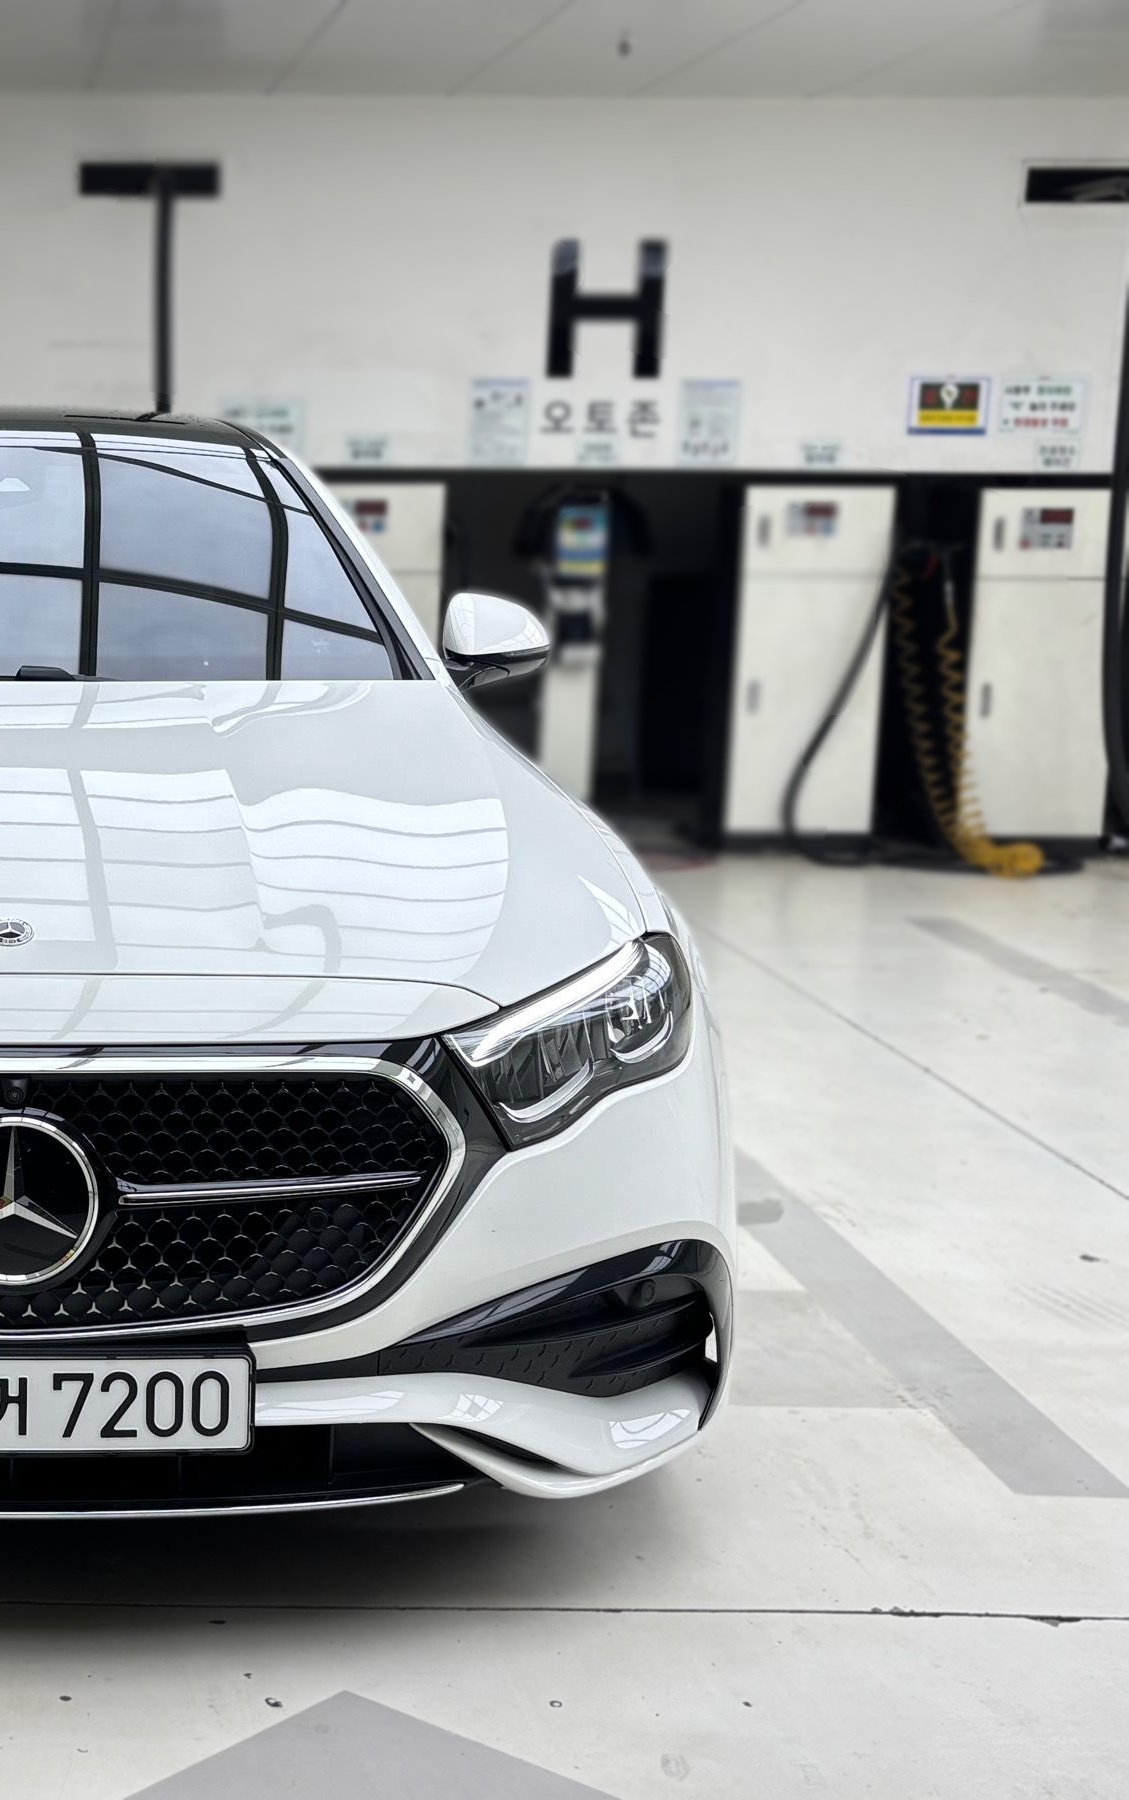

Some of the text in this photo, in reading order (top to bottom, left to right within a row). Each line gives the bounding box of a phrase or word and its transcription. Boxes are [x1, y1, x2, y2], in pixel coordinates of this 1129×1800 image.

[545, 237, 670, 380] H
[540, 400, 661, 438] 오토존
[52, 1370, 231, 1438] 7200
